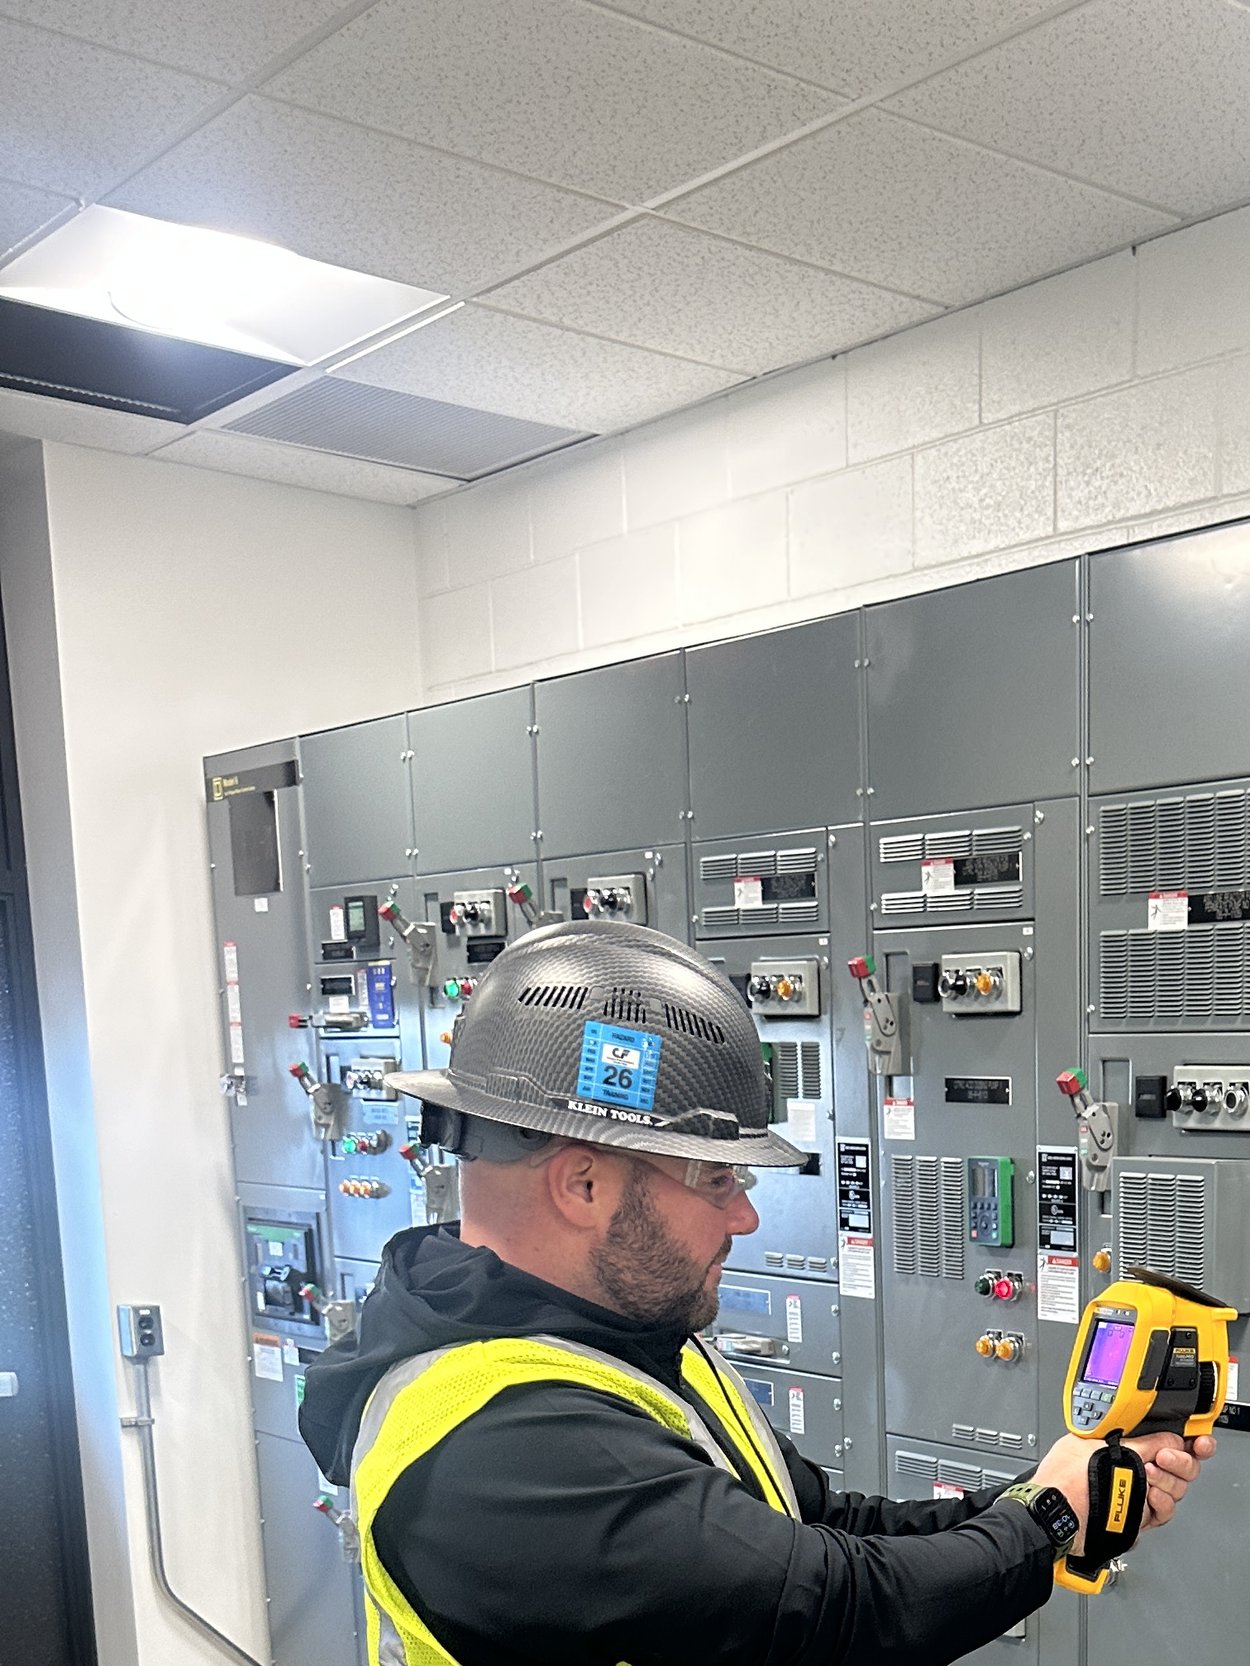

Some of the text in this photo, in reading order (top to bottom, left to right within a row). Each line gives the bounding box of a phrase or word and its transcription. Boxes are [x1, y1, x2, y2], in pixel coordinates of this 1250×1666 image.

[602, 1065, 633, 1089] 26
[568, 1101, 608, 1117] KLEIN
[1114, 1479, 1127, 1522] FLUKE
